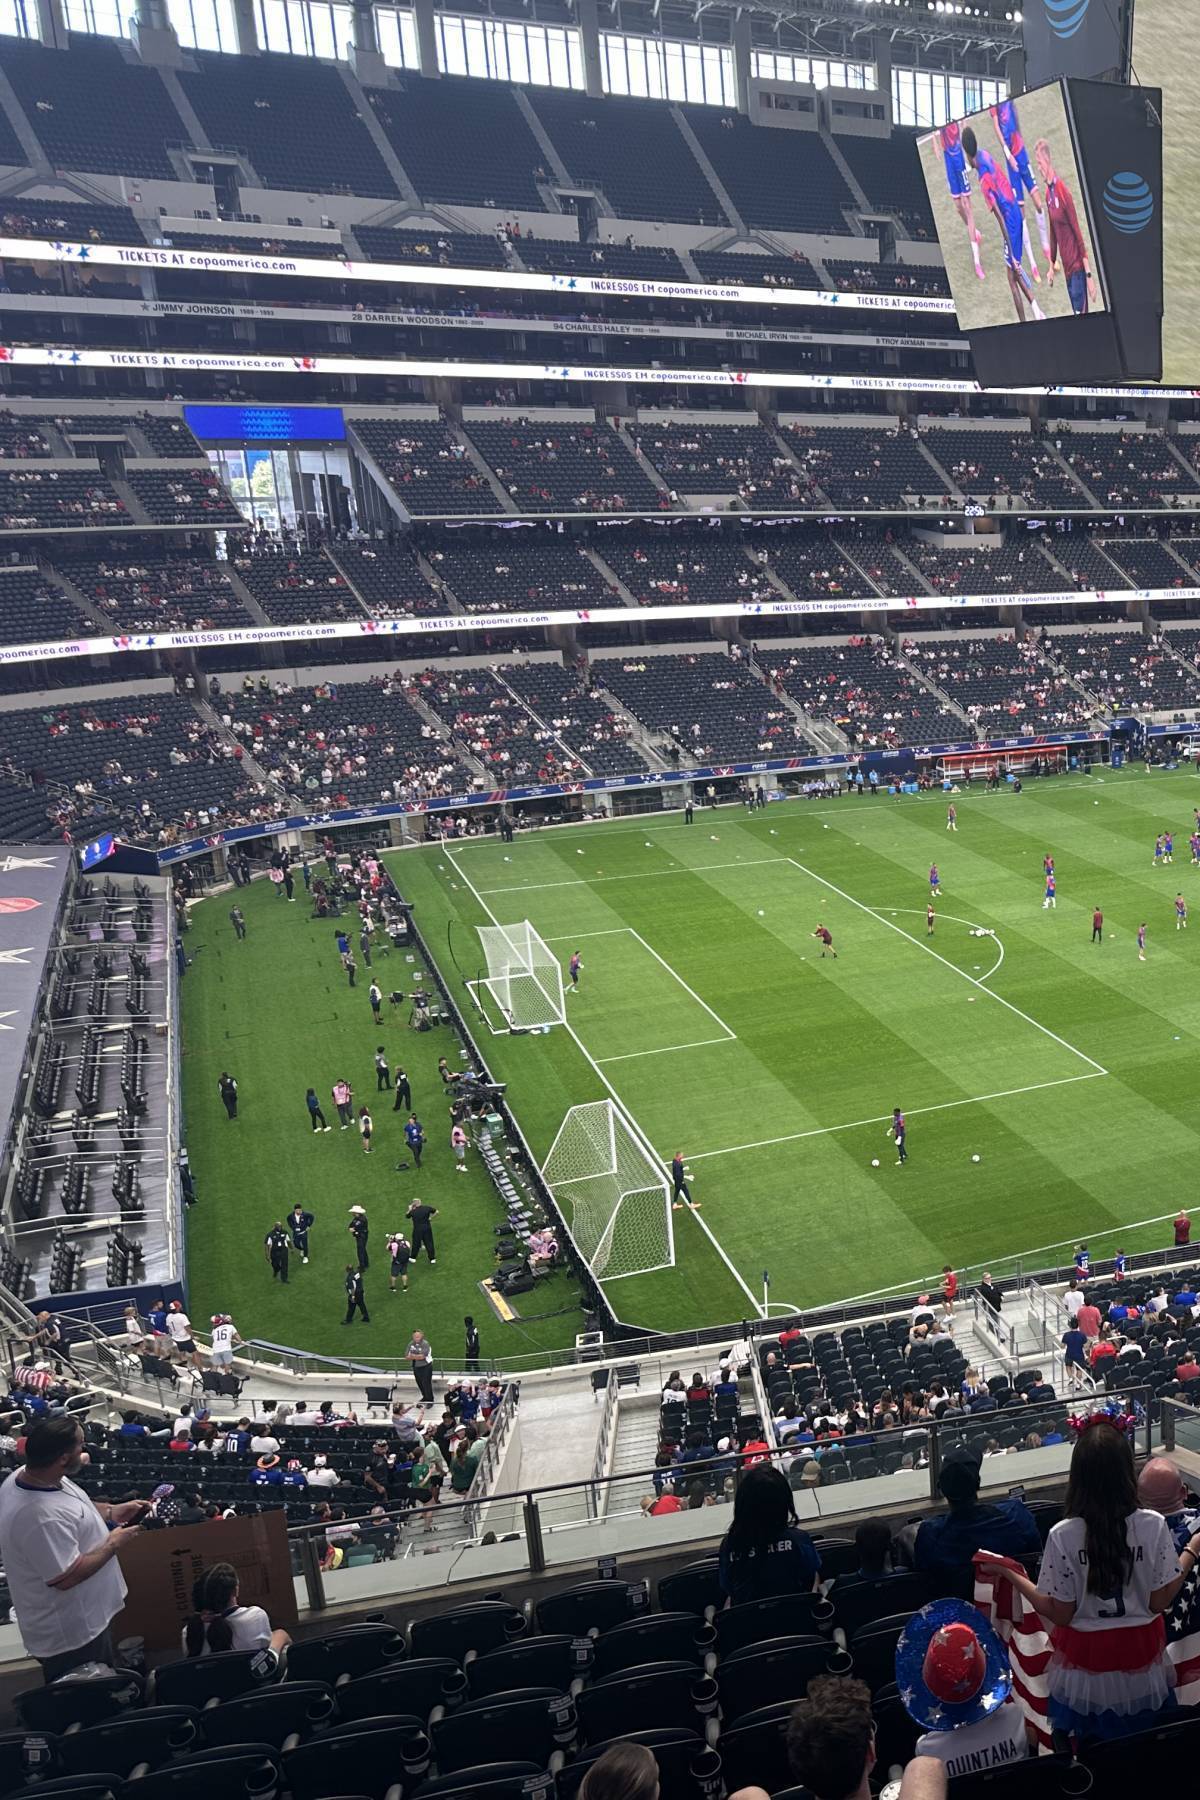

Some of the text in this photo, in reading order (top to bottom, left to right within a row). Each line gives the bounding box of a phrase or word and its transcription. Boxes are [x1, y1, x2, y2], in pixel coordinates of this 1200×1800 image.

[118, 250, 296, 271] TICKETS AT copaamerica.com
[591, 281, 739, 298] INGRESSOS EM copaamerica.com
[857, 297, 889, 306] TICKETS
[892, 299, 901, 307] AT
[152, 303, 184, 313] JIMMY
[186, 305, 235, 316] JOHNSON
[352, 313, 362, 321] 28
[365, 314, 404, 323] DARREN
[407, 316, 454, 325] WOODSON
[553, 323, 564, 331] 94
[565, 324, 603, 332] CHARLES
[604, 325, 631, 333] HALEY
[736, 331, 767, 340] MICHAEL
[110, 355, 158, 365] TICKETS
[163, 356, 176, 366] AT
[584, 370, 632, 379] INGRESSOS
[635, 372, 648, 380] EM
[851, 379, 884, 388] TICKETS
[420, 621, 454, 629] TICKETS
[470, 616, 549, 627] copaamerica.com
[172, 627, 336, 645] INGRESSOS EM copaamerica.com
[216, 1328, 227, 1342] 16
[227, 1439, 238, 1452] 10
[171, 1561, 189, 1612] CLOTHING
